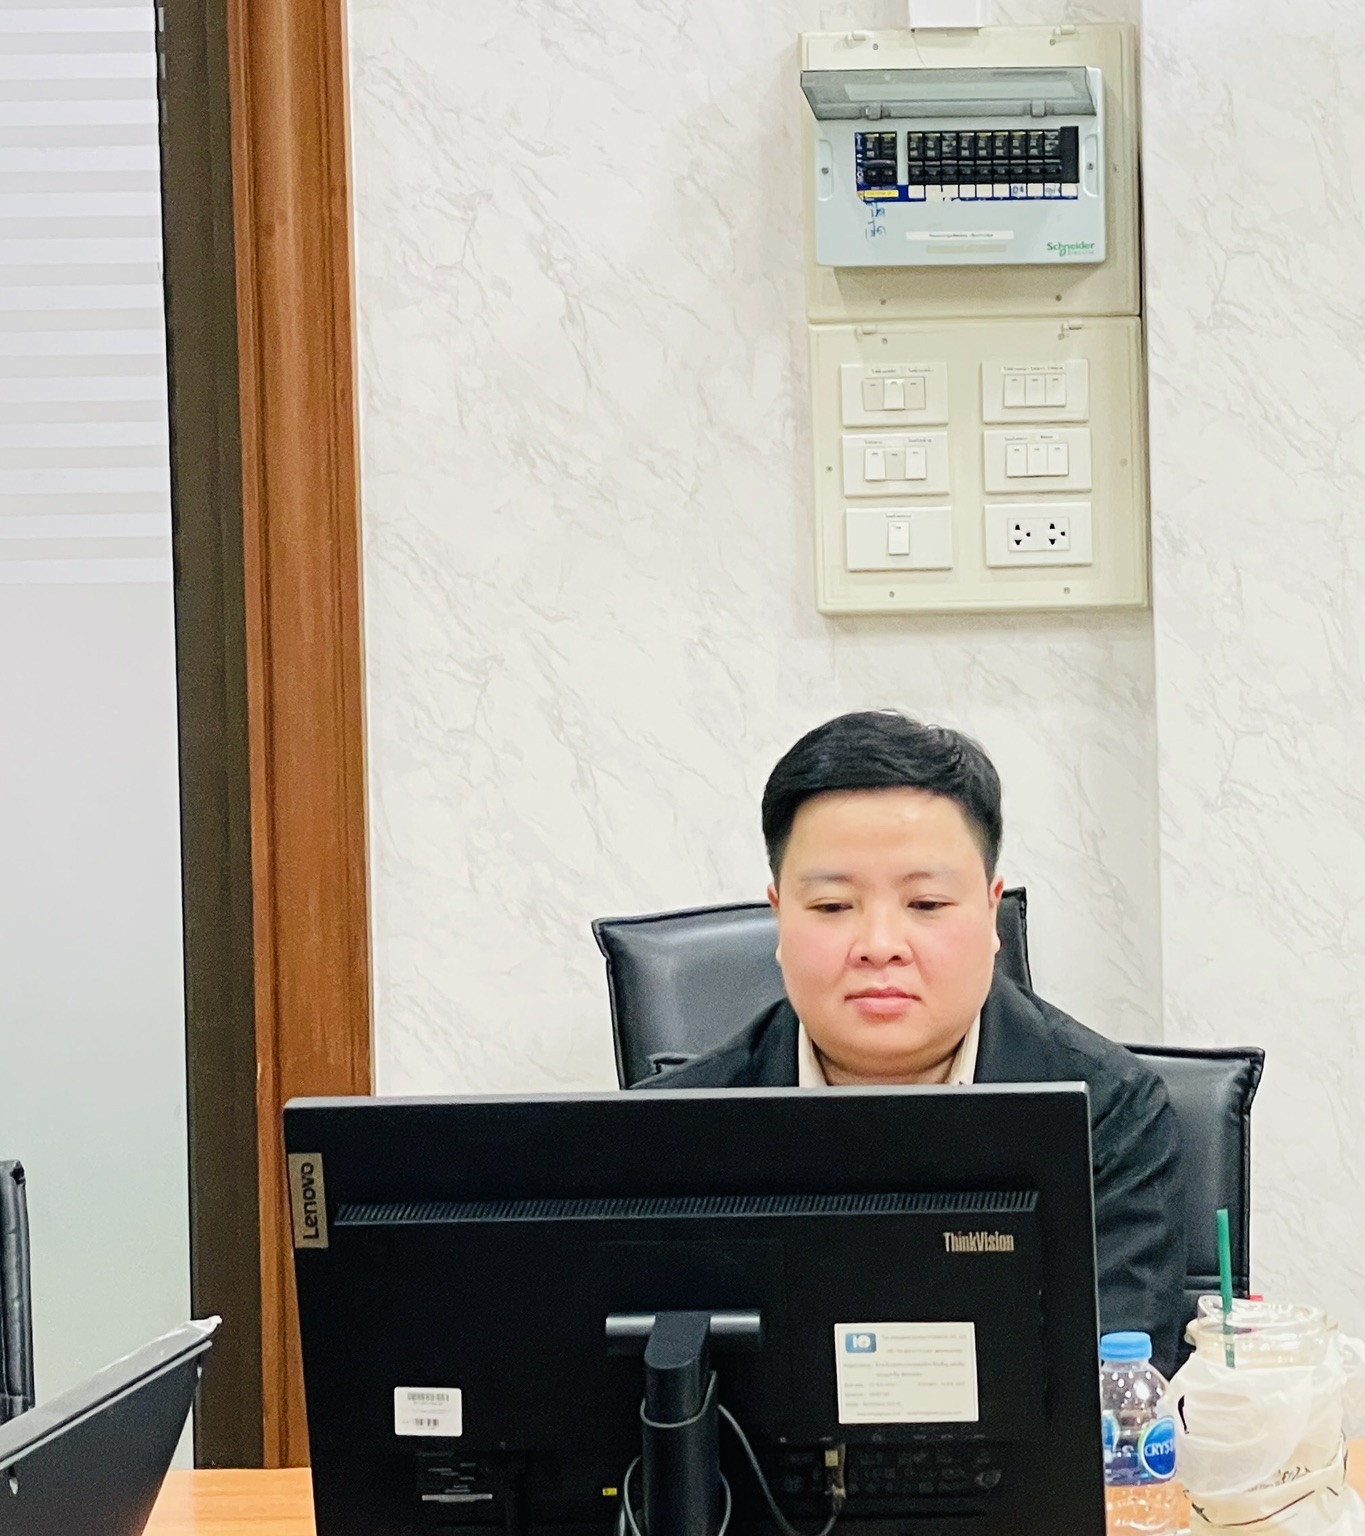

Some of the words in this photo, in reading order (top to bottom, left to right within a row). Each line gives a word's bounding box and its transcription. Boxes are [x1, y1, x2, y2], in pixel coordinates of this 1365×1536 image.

[1046, 241, 1095, 256] Schneider
[300, 1162, 319, 1239] Lenovo
[942, 1230, 1015, 1252] ThinkVision
[1144, 1438, 1175, 1457] CRYST
